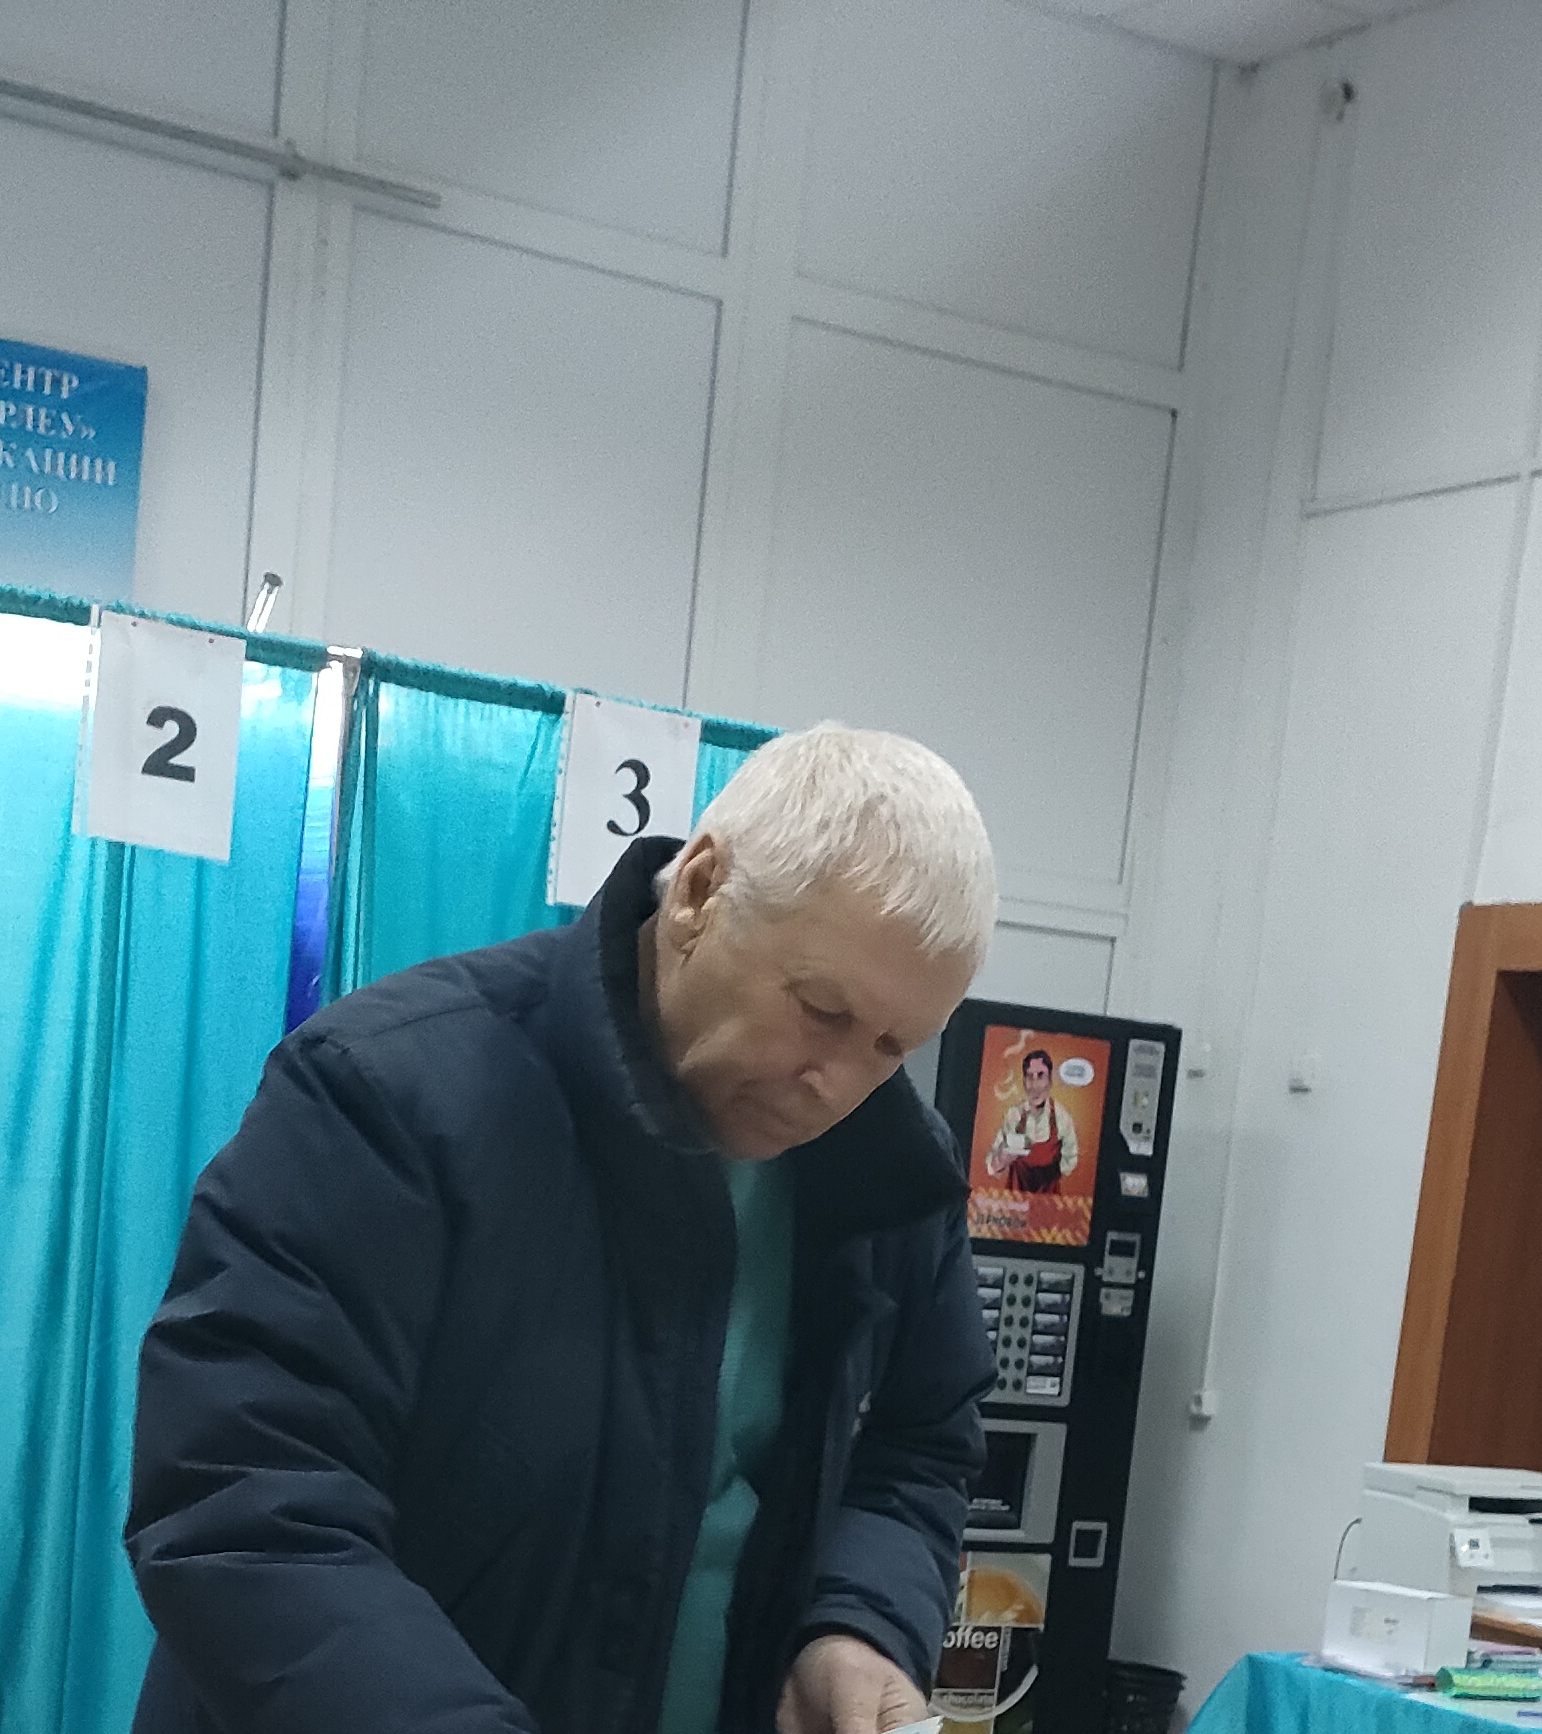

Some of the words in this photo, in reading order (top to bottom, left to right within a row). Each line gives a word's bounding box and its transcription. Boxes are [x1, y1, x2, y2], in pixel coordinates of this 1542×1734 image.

[9, 481, 59, 514] ПО
[139, 704, 198, 784] 2
[605, 758, 652, 838] 3
[942, 1624, 1000, 1650] offee
